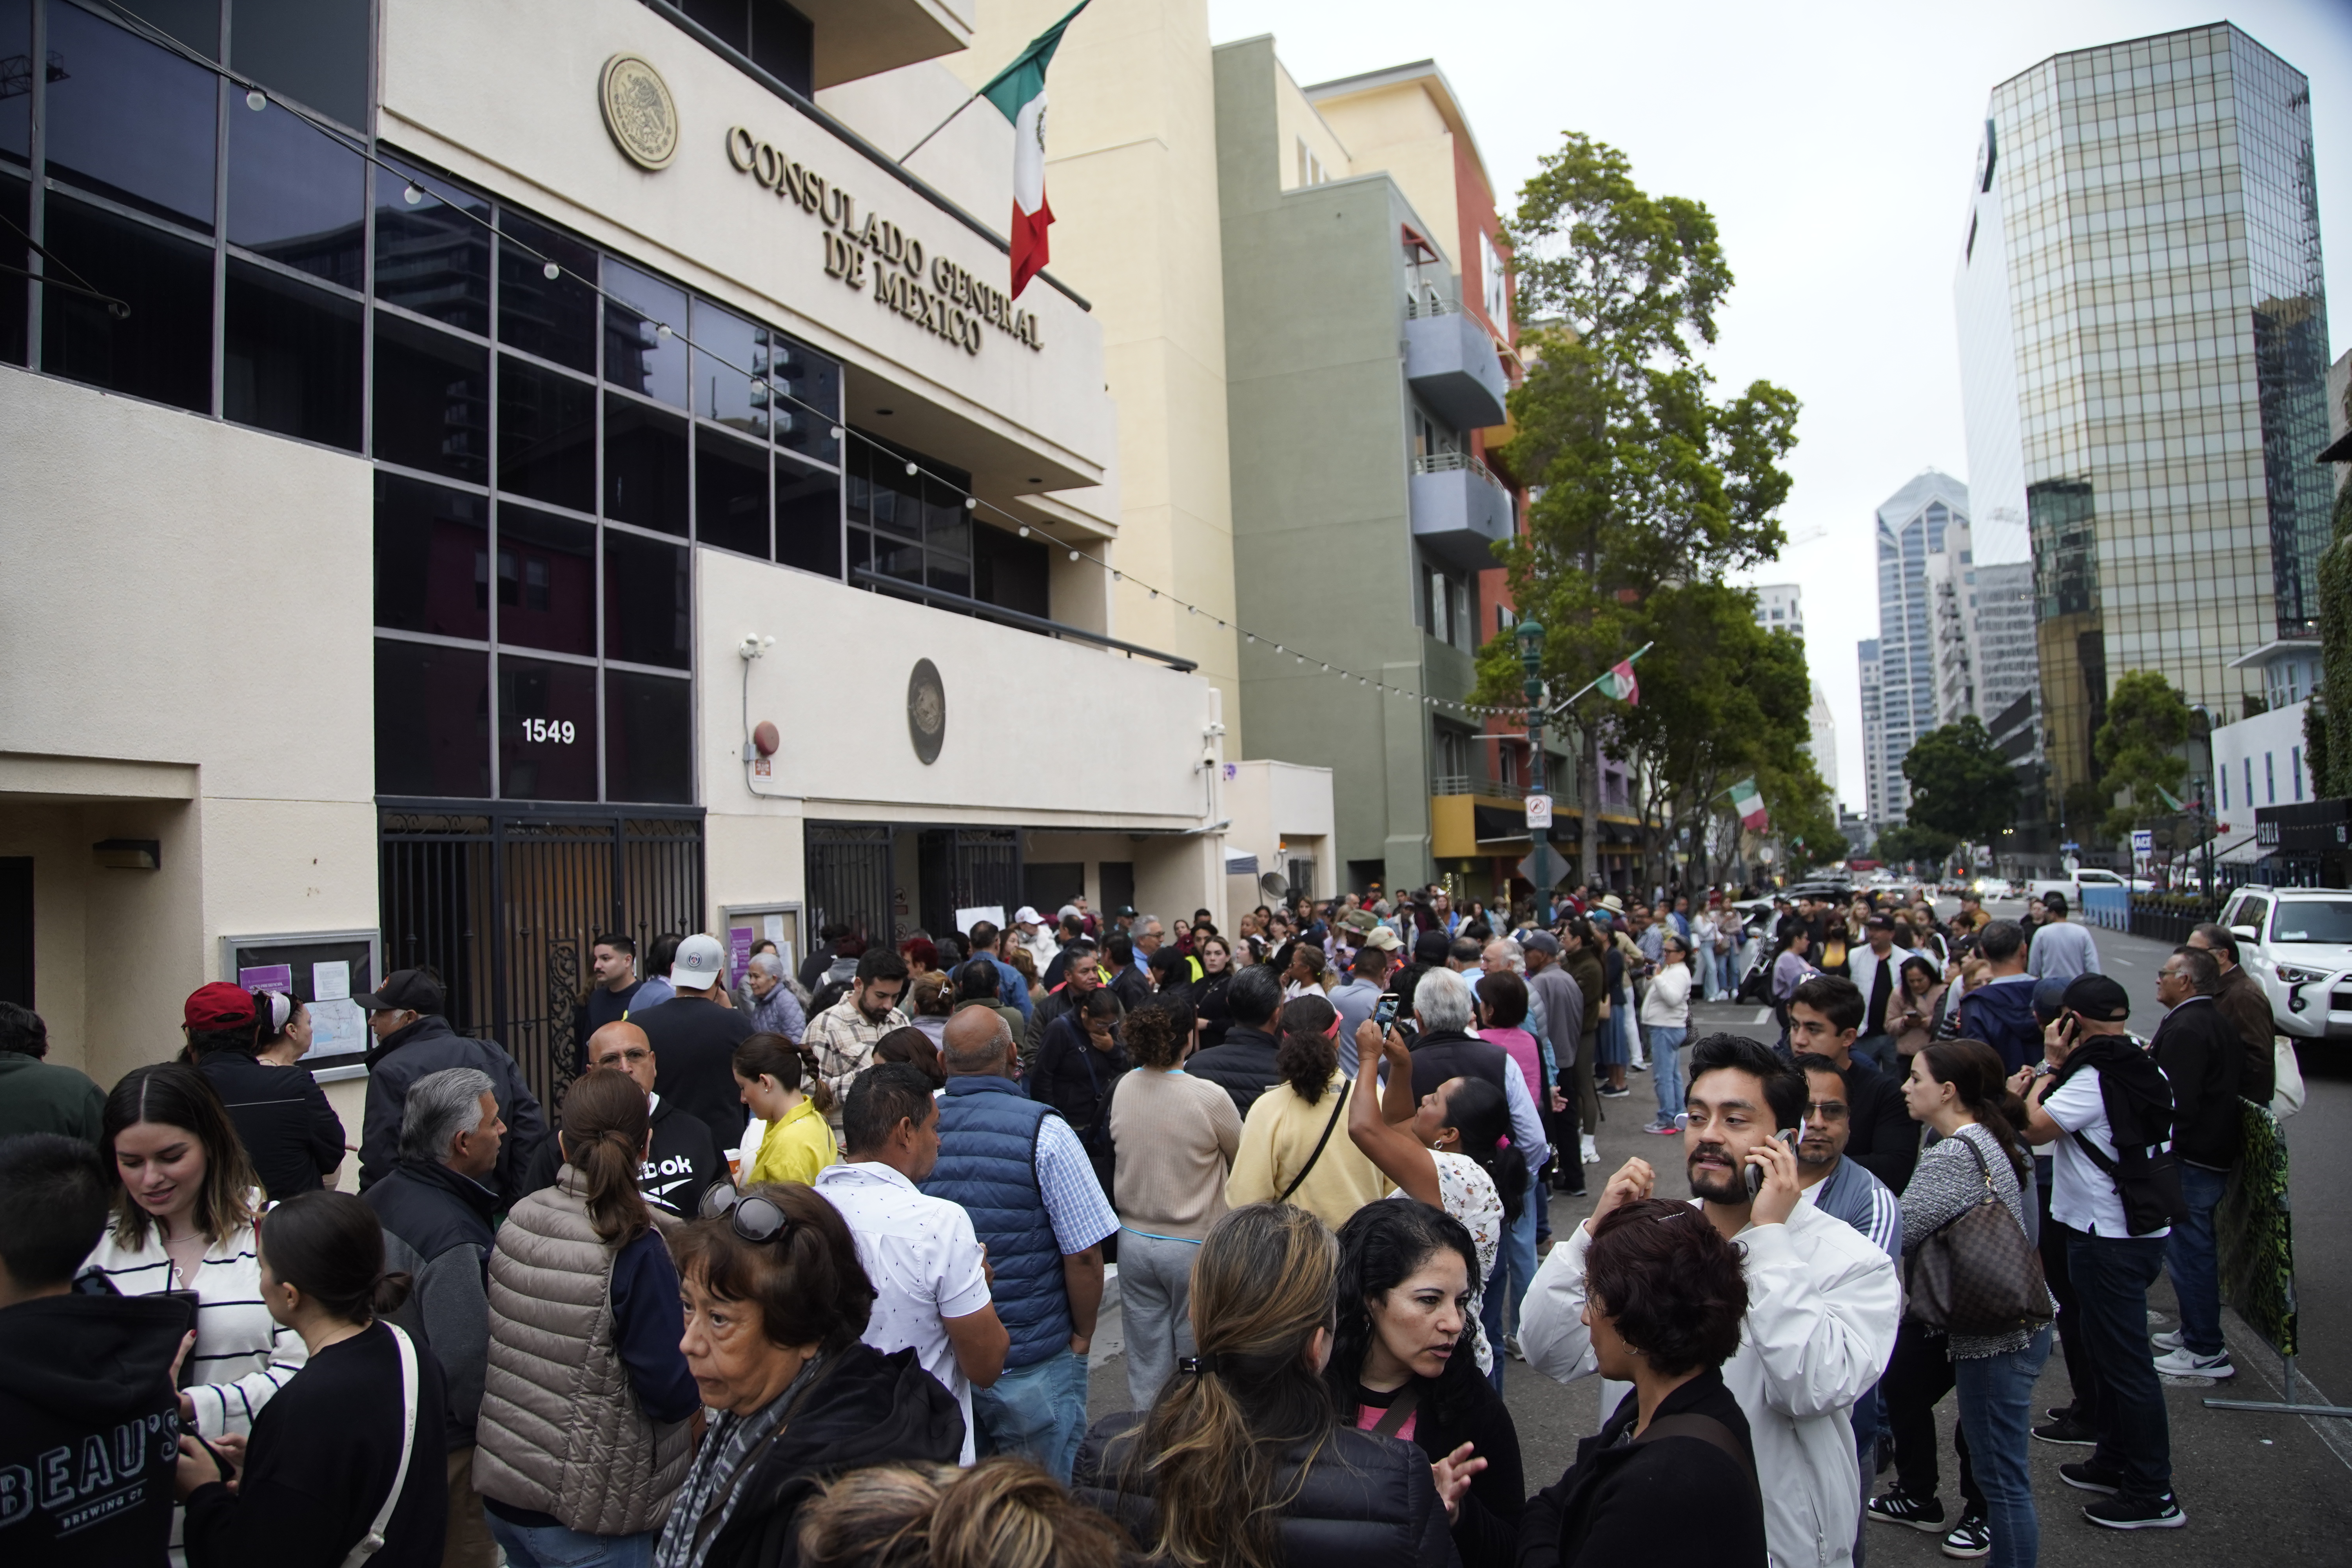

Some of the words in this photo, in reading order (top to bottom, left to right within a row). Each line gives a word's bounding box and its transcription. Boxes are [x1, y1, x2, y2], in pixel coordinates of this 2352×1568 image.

[726, 126, 927, 278] CONSULADO
[932, 255, 1044, 351] GENERAL
[823, 230, 866, 290] DE
[873, 261, 984, 356] MEXICO
[523, 718, 575, 744] 1549
[2258, 821, 2280, 844] ISOLA
[0, 1408, 180, 1527] BEAU'S
[63, 1495, 124, 1529] BREWING
[2161, 1504, 2176, 1518] PUMA
